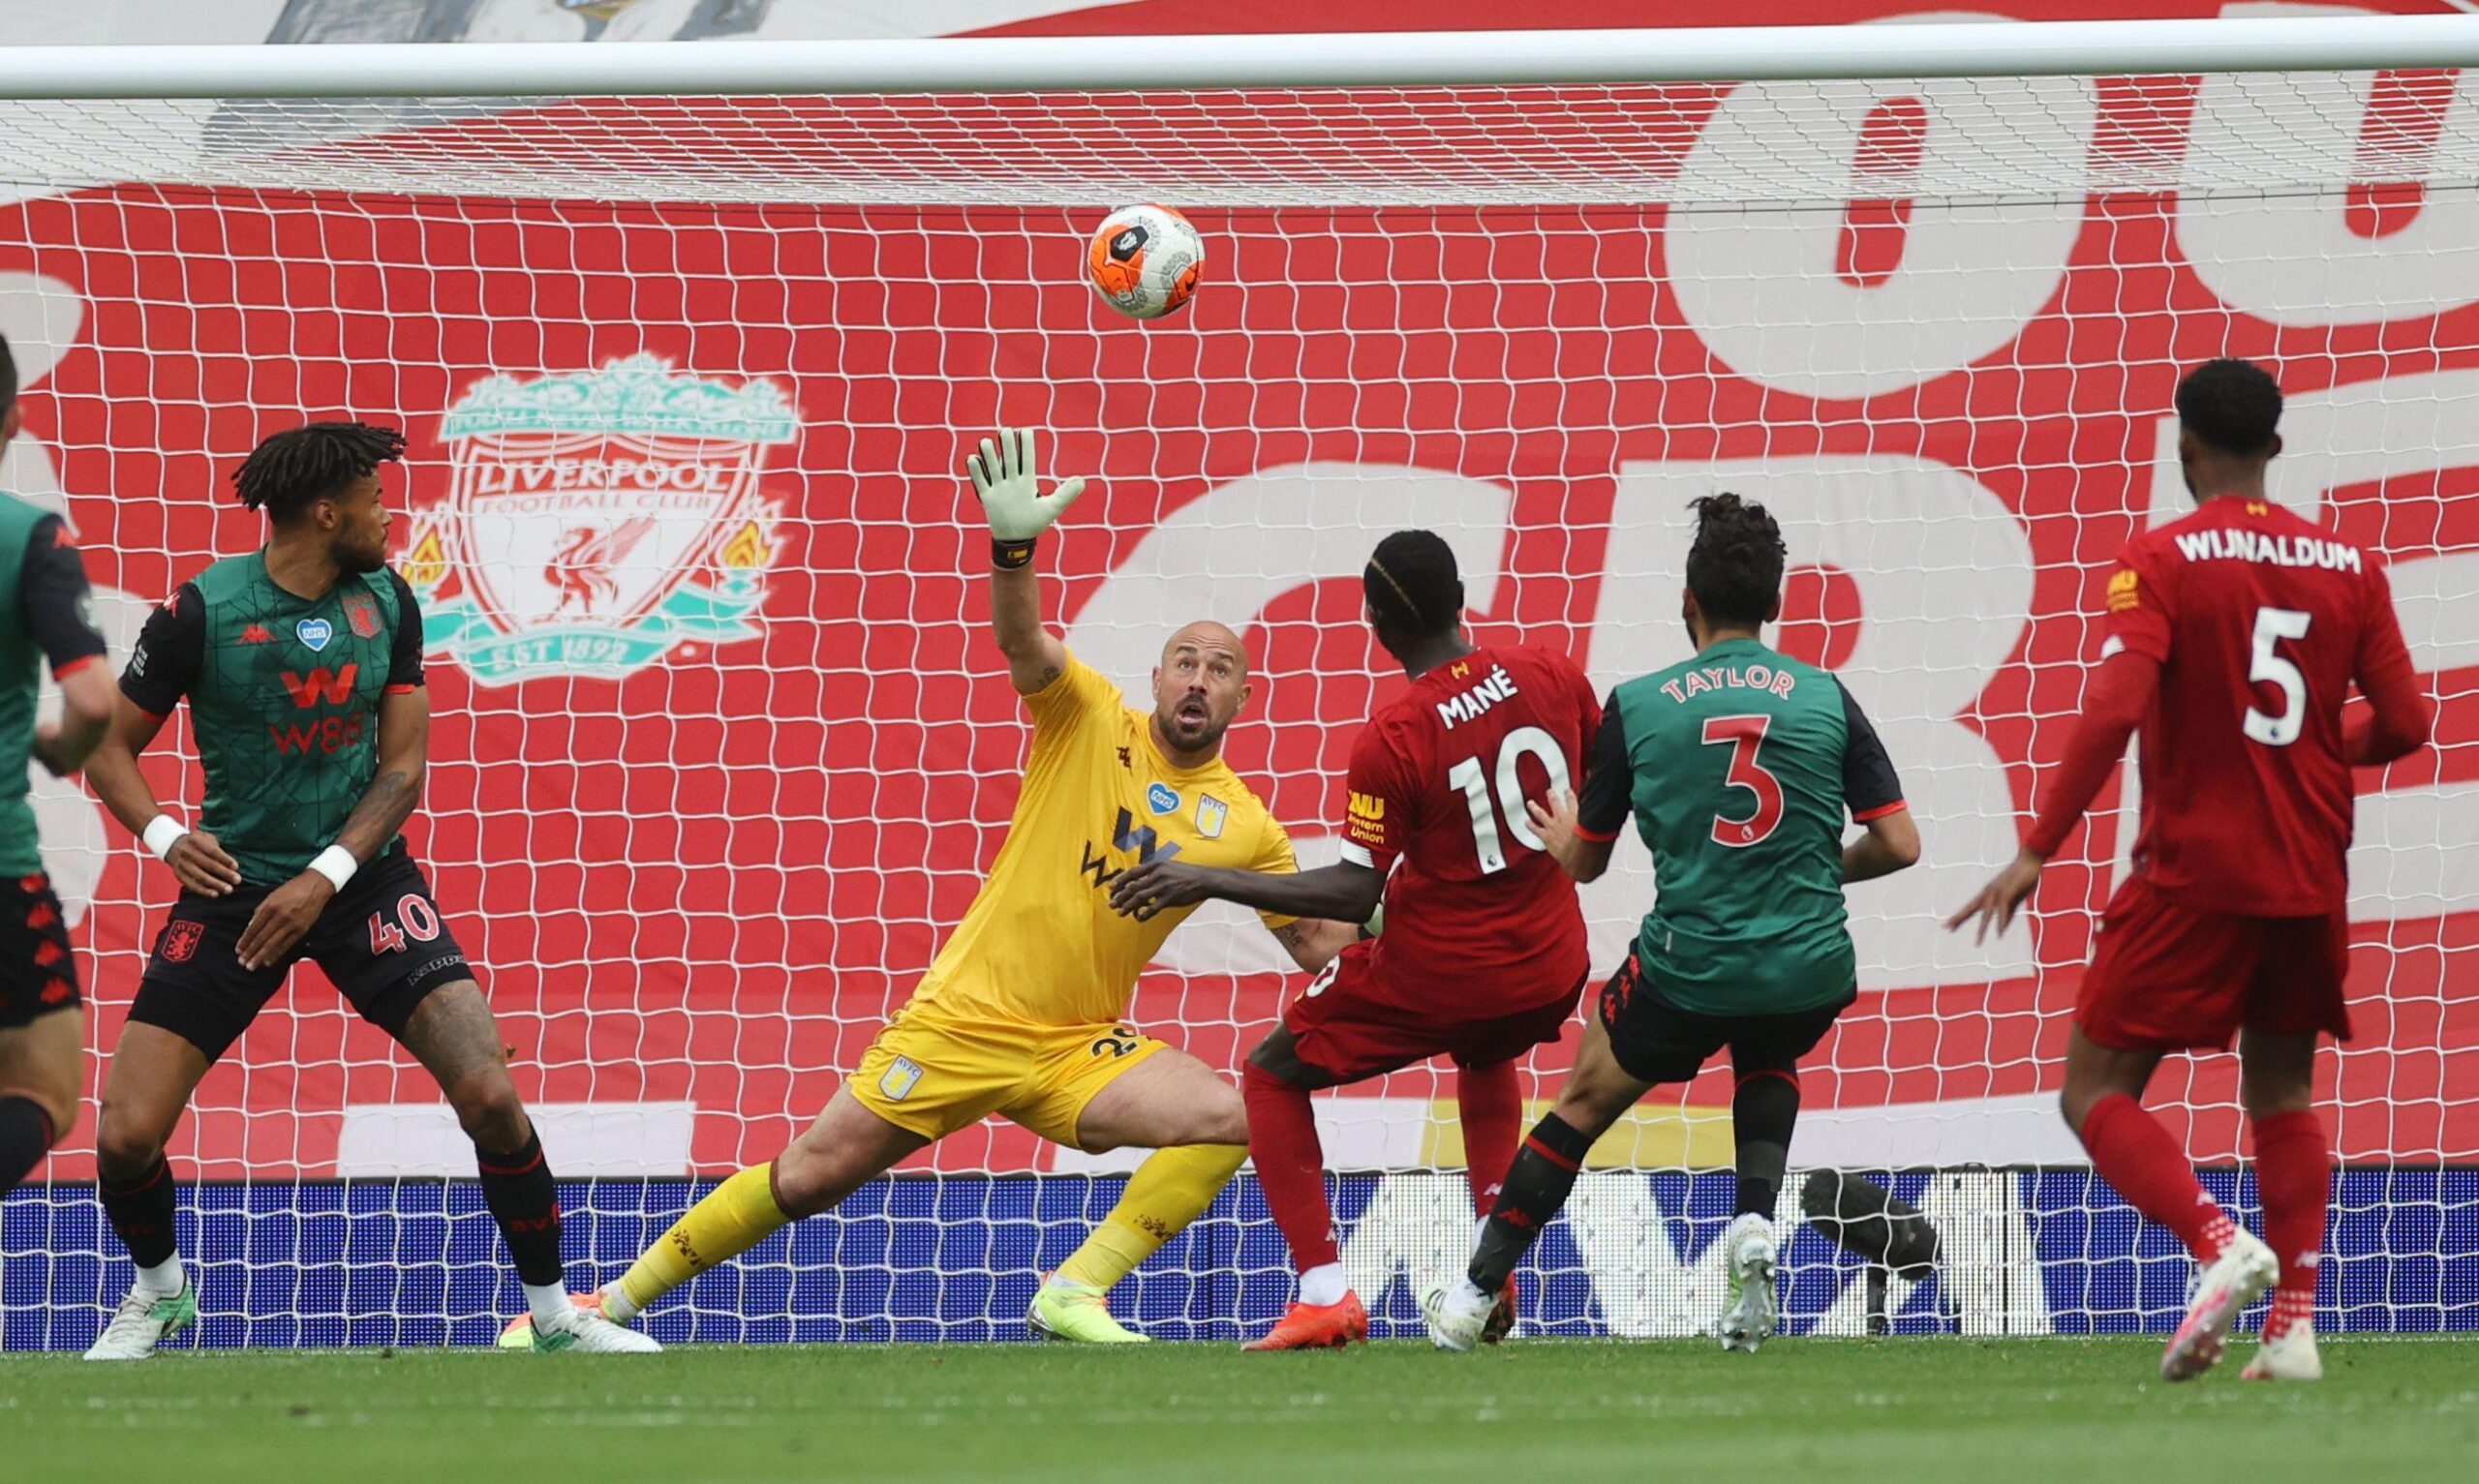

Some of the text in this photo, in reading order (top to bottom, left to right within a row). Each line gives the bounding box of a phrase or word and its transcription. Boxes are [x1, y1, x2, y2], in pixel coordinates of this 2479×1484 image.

[477, 457, 728, 495] LIVERPOOL
[481, 493, 710, 516] FOOTBALL CLUB
[2174, 528, 2362, 575] WIJNALDUM
[1436, 663, 1519, 730] MANÉ
[1660, 665, 1795, 704] TAYLOR
[2243, 606, 2311, 746] 5
[1449, 726, 1571, 875] 10
[1701, 713, 1785, 848] 3
[1202, 796, 1224, 813] AVFC
[1350, 826, 1385, 844] Union
[368, 893, 440, 956] 40
[1091, 1027, 1139, 1059] 2
